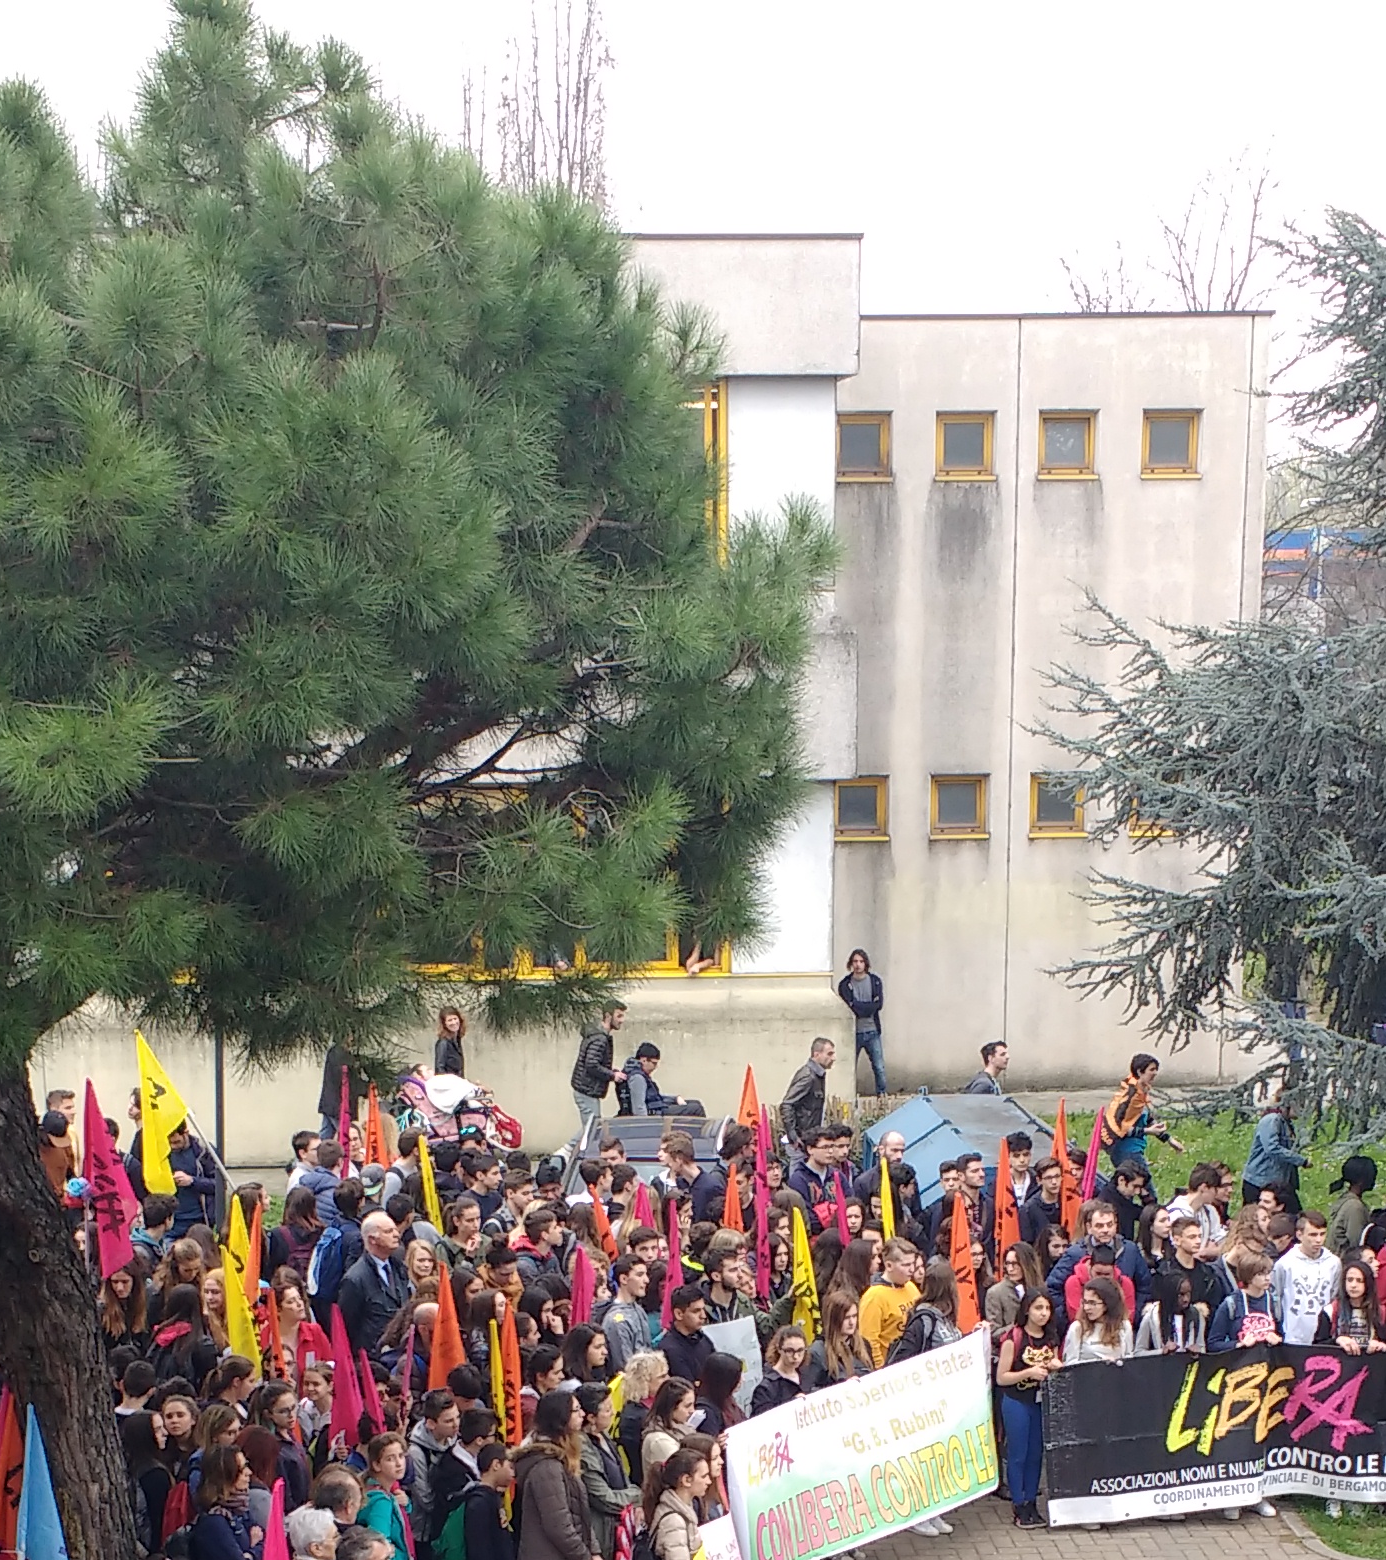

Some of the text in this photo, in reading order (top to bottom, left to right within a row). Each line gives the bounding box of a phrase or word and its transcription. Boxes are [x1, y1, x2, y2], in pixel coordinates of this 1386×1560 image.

[845, 1370, 922, 1409] Speriore
[870, 1434, 971, 1523] CONTRO
[1180, 1465, 1215, 1485] NOMI
[1219, 1463, 1227, 1478] E
[1229, 1457, 1265, 1478] NUME
[1267, 1447, 1353, 1474] CONTRO
[1356, 1453, 1379, 1474] LE
[1153, 1482, 1255, 1506] COORDINAMENTO
[1312, 1474, 1324, 1487] DI
